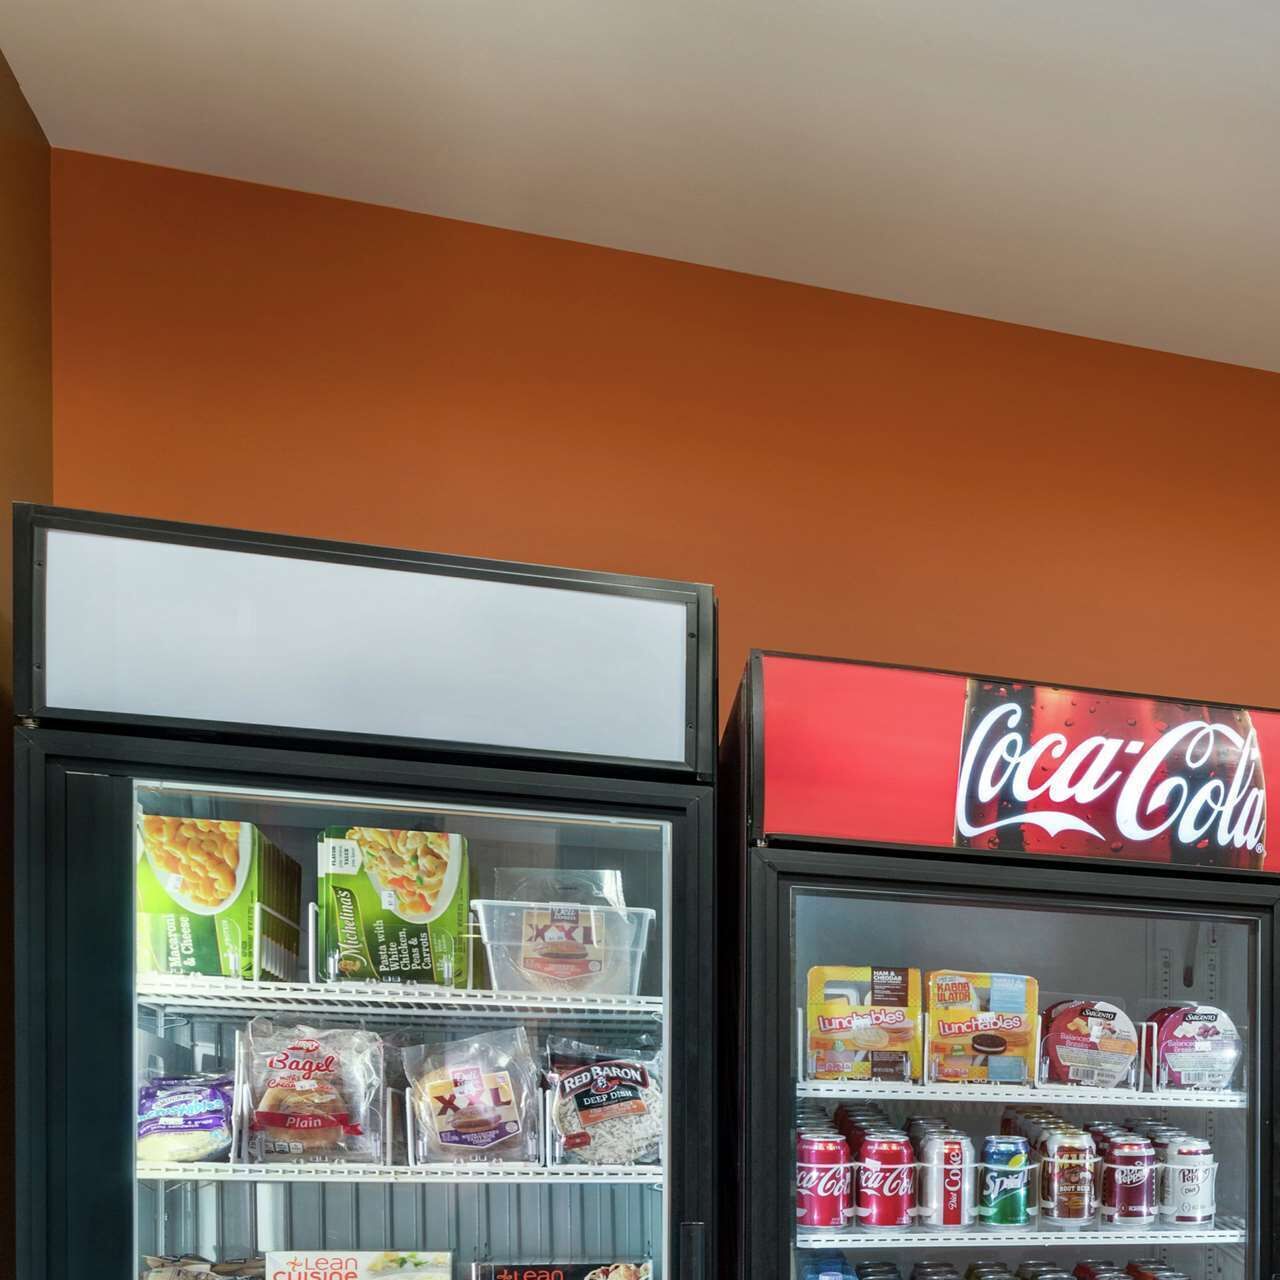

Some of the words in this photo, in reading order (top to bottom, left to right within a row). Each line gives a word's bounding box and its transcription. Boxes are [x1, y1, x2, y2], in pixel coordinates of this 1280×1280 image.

[955, 702, 1264, 850] Coca-Cola
[180, 915, 191, 955] Cheese
[338, 889, 367, 967] Michelina's
[373, 918, 384, 943] with
[378, 945, 390, 973] Pasta
[390, 941, 400, 972] White
[400, 927, 411, 971] Chicken,
[411, 947, 422, 970] Peas
[421, 932, 433, 970] Carrots
[1082, 1008, 1116, 1020] SARGENTO
[268, 1052, 336, 1080] Bagel
[563, 1071, 592, 1093] RED
[592, 1064, 643, 1083] BARON
[583, 1094, 609, 1106] DEEP
[610, 1090, 634, 1101] DISH
[285, 1116, 322, 1129] Plain
[945, 1150, 962, 1192] Coke
[305, 1256, 358, 1270] Lean
